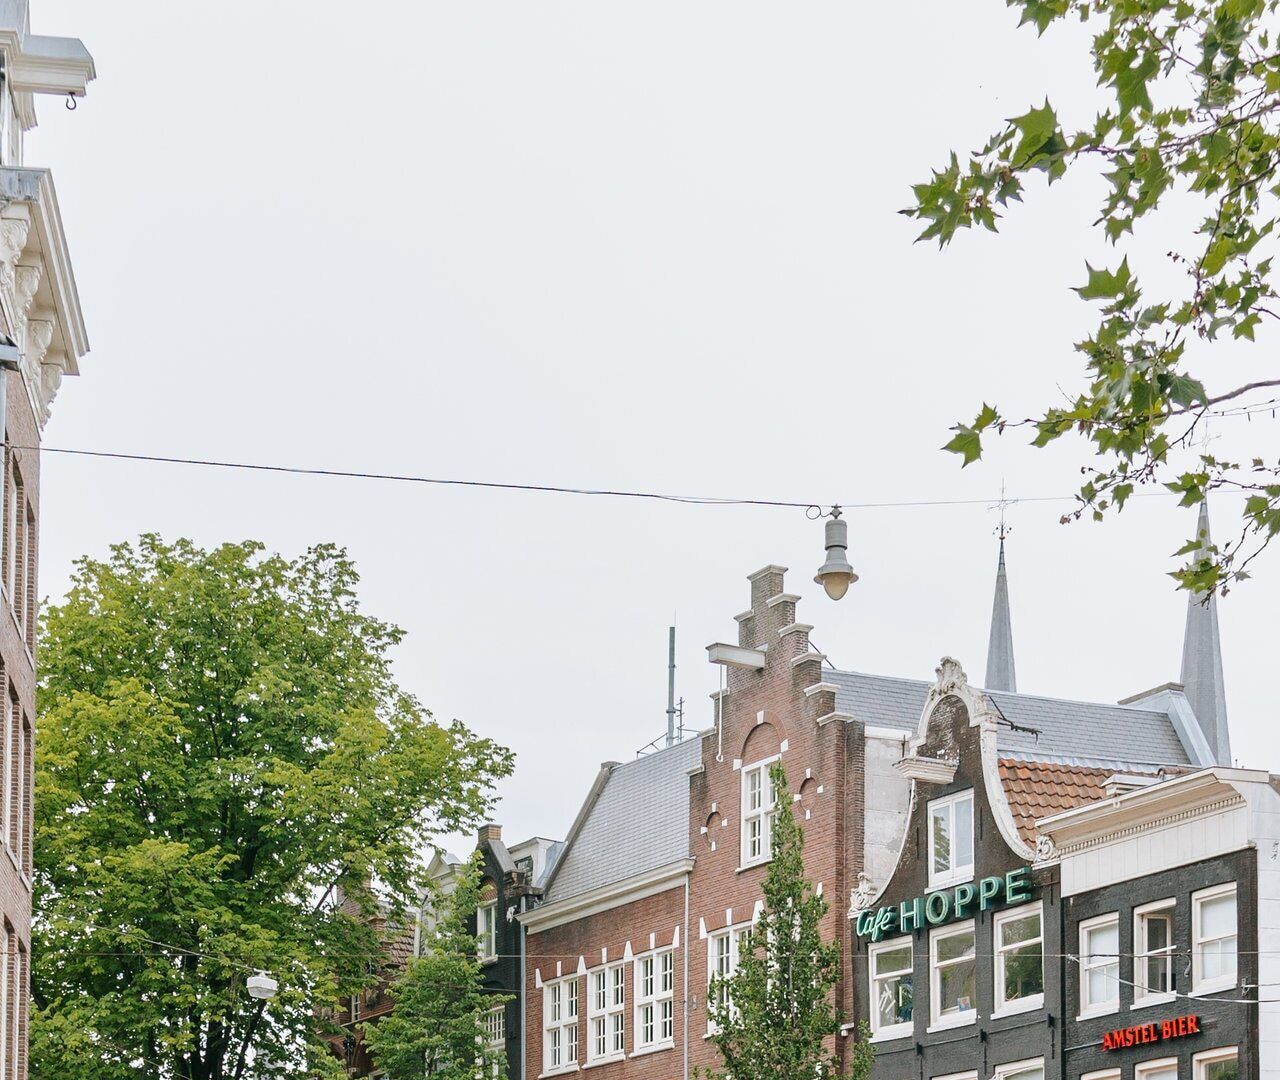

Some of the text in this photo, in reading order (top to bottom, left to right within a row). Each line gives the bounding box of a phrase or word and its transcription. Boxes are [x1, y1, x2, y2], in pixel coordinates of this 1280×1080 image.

[856, 867, 1031, 943] Café HOPPE
[1102, 1014, 1199, 1051] AMSTEL BIER
